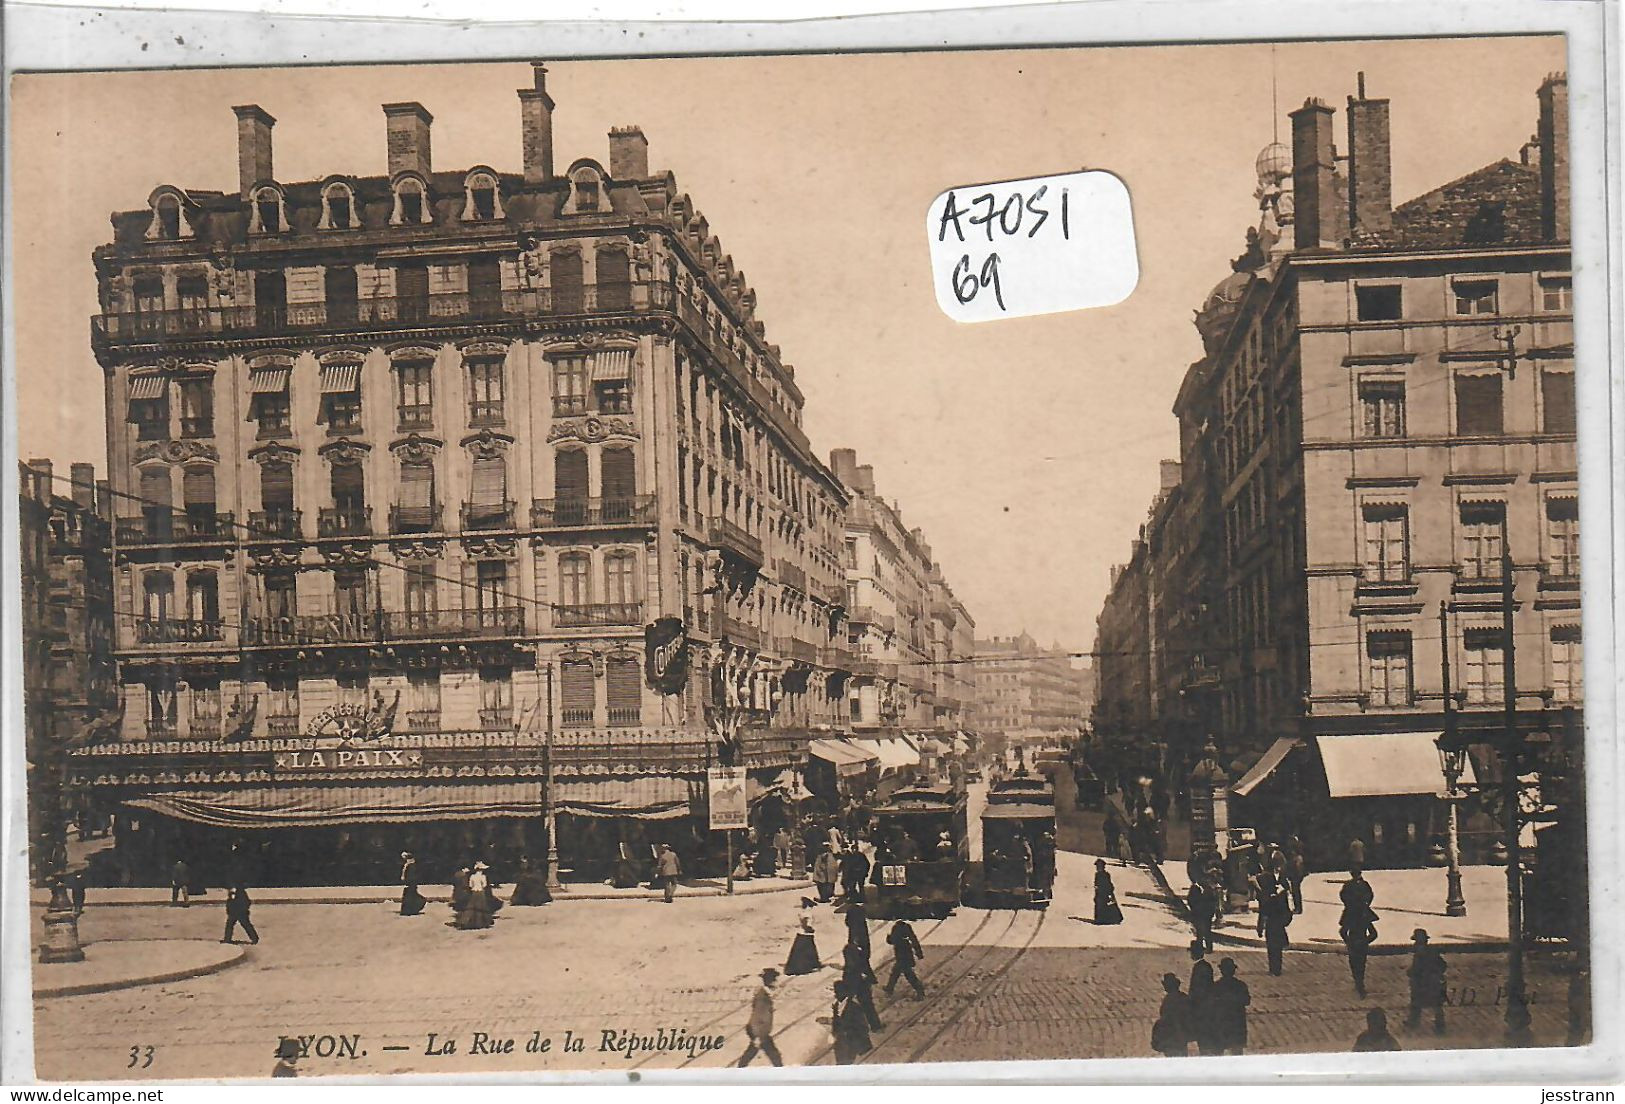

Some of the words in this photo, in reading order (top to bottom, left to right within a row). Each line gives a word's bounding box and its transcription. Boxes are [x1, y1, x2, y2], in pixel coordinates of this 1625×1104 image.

[952, 252, 1006, 311] 69
[291, 751, 327, 768] LA
[337, 750, 404, 767] PAIX
